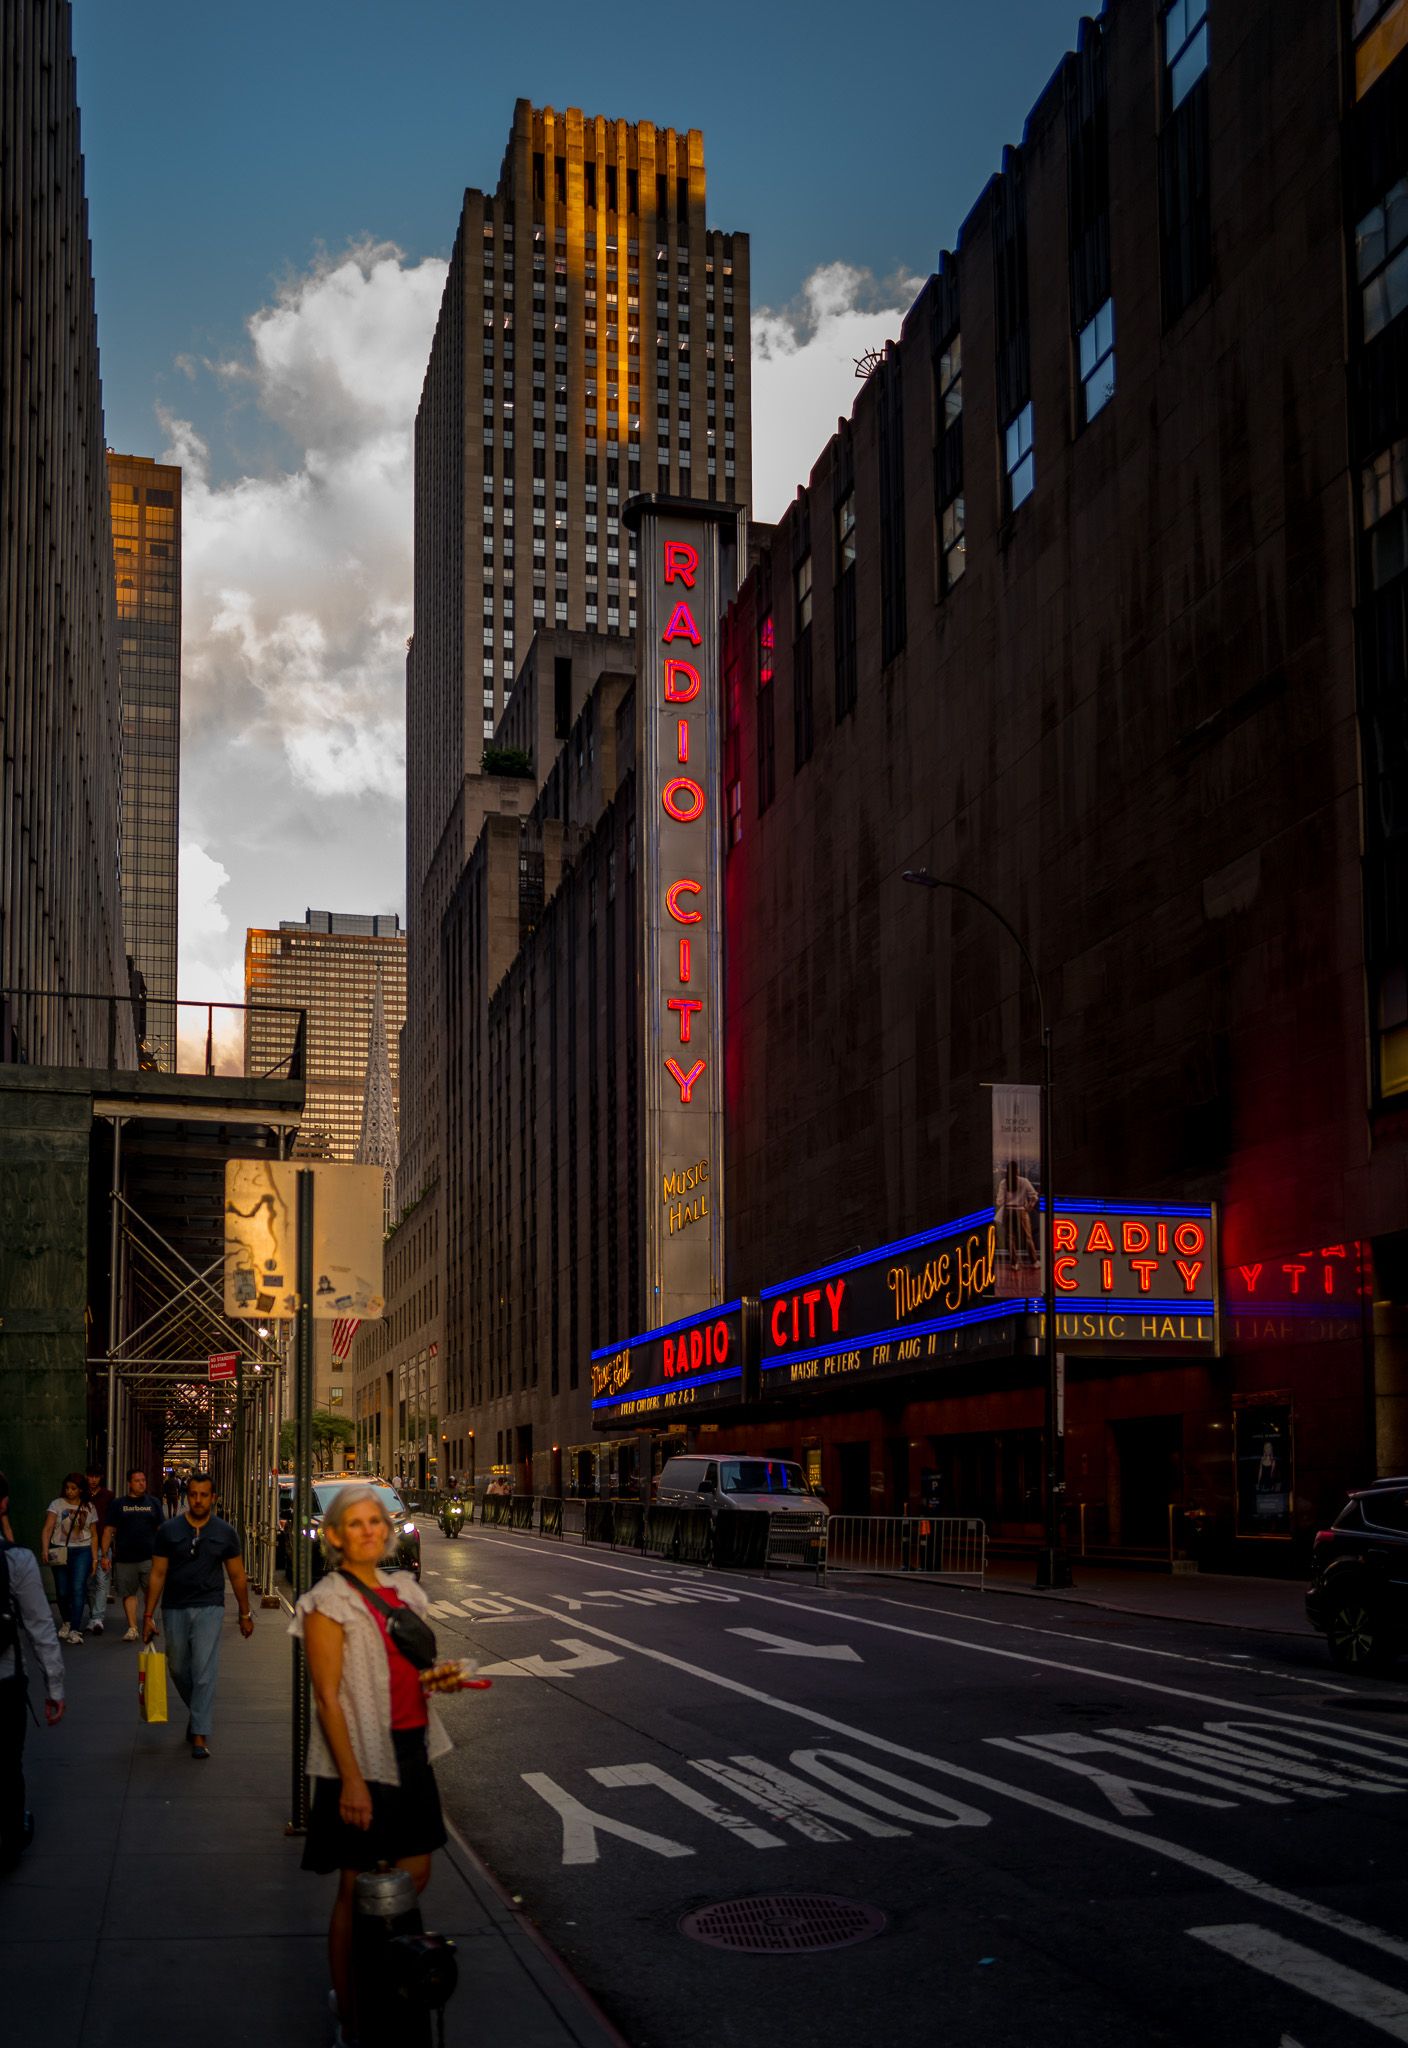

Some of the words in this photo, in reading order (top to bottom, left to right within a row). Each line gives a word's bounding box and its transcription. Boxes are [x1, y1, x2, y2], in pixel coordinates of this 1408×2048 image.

[662, 541, 705, 821] RADIO
[665, 879, 707, 1103] CITY
[663, 1159, 709, 1204] MUSIC
[668, 1195, 709, 1236] HALL
[1054, 1219, 1205, 1255] RADIO
[771, 1279, 846, 1348] CITY
[887, 1254, 950, 1321] Music
[945, 1225, 996, 1311] Hal
[1054, 1256, 1203, 1292] CITY
[663, 1320, 729, 1378] RADIO
[1040, 1315, 1125, 1337] MUSIC
[1142, 1317, 1209, 1340] HALL
[790, 1359, 819, 1381] MAISIE
[824, 1350, 861, 1375] PETERS
[897, 1337, 921, 1361] AUG
[927, 1334, 937, 1355] 11
[636, 1396, 660, 1412] CHILDERS
[664, 1391, 676, 1407] AUG
[546, 1586, 741, 1611] ONLY
[980, 1720, 1408, 1817] ONLY
[520, 1748, 992, 1865] ONLY
